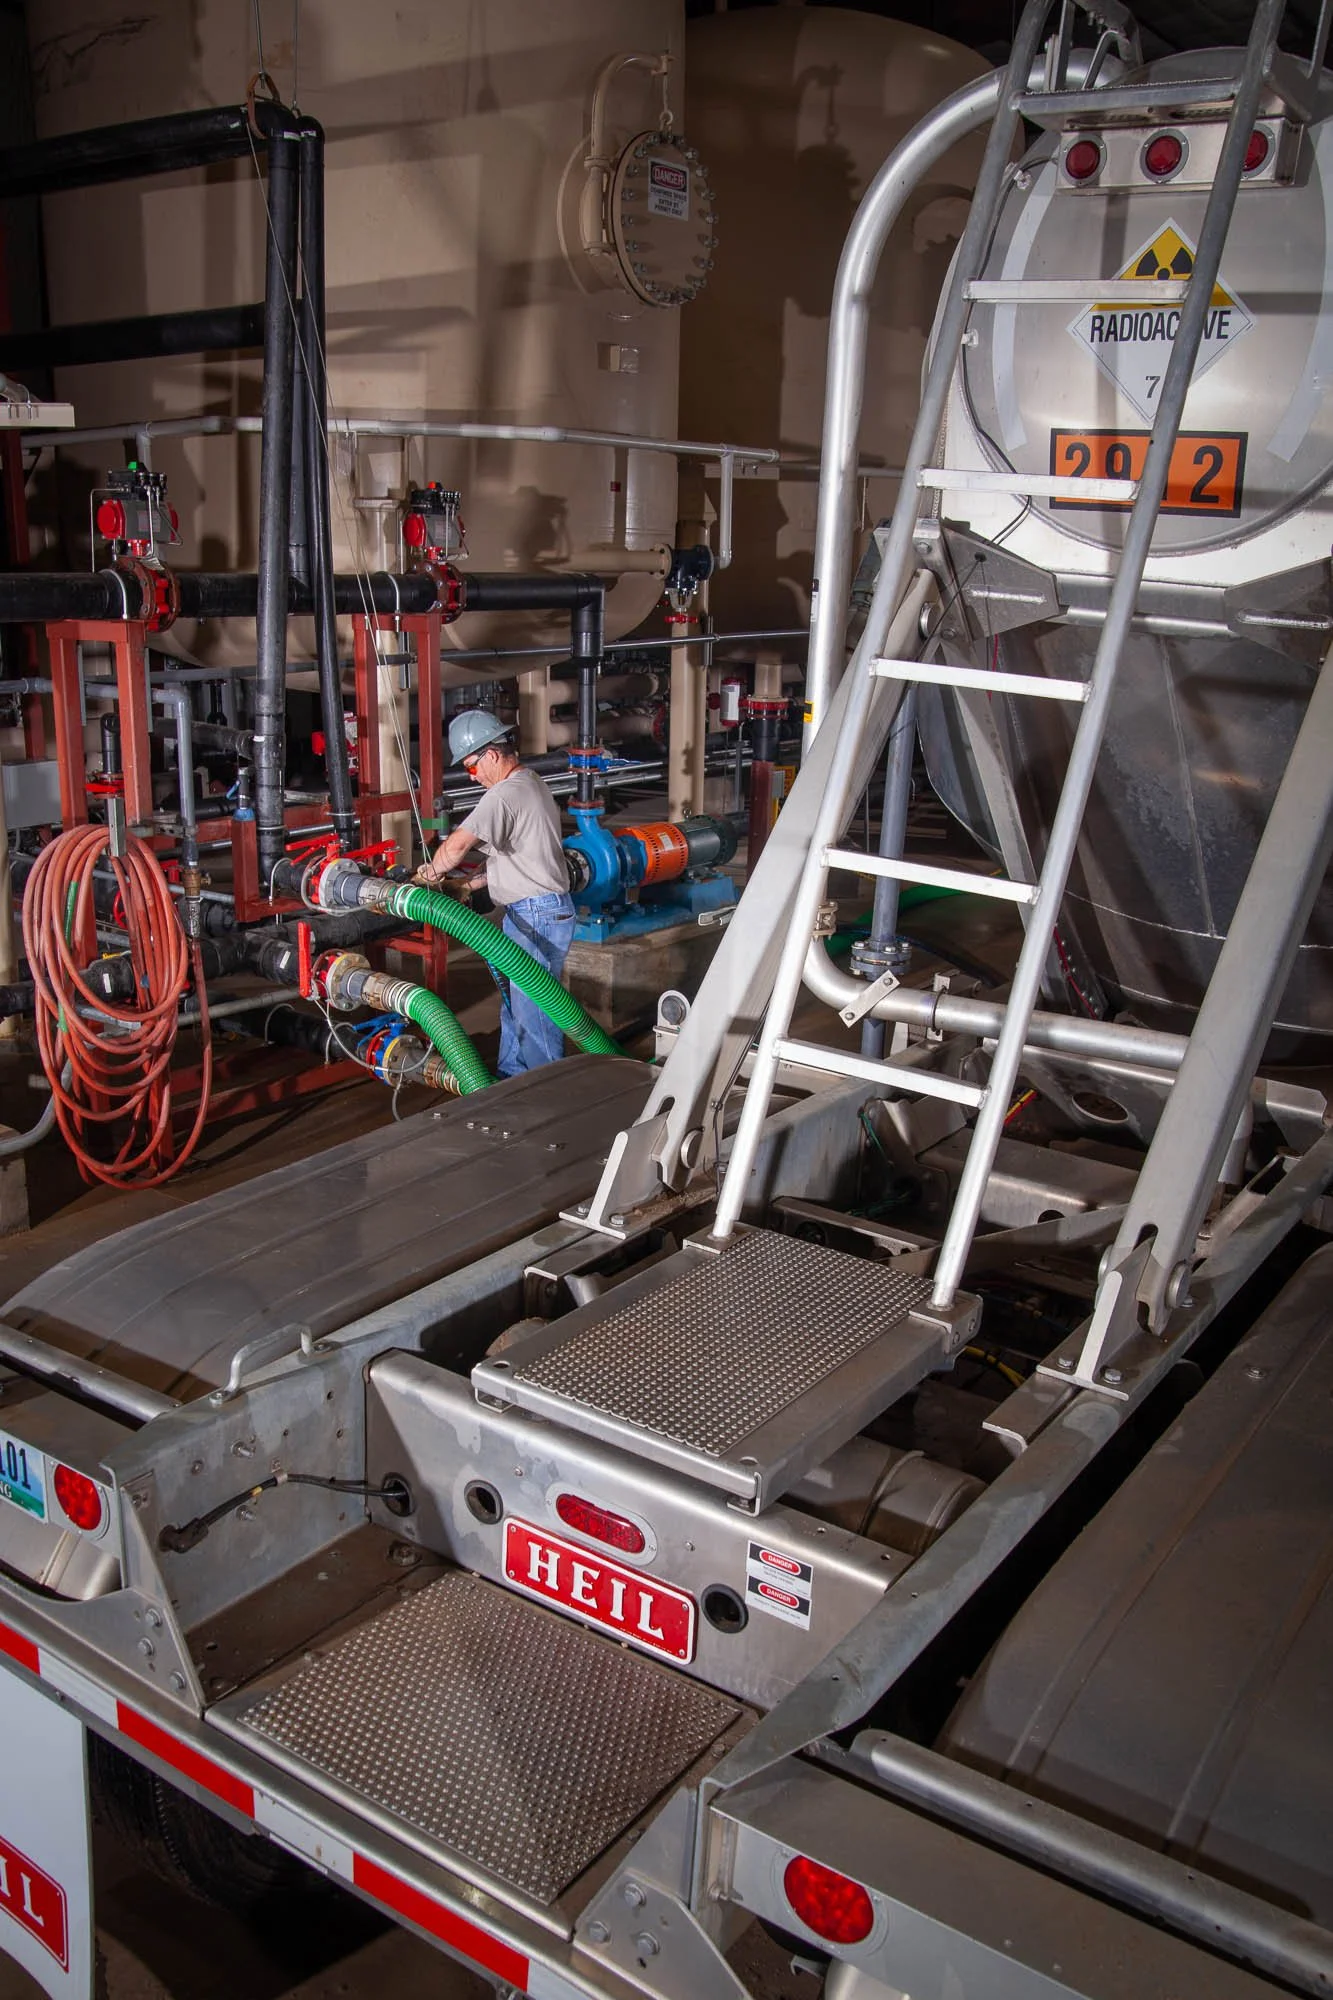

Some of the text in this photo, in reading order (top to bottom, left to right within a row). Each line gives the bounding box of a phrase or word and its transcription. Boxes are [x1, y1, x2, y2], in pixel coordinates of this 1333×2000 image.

[655, 167, 685, 186] DANGER
[1090, 309, 1232, 343] RADIOACVE
[1145, 375, 1161, 399] 7
[1065, 442, 1224, 504] 292
[767, 1554, 793, 1570] DANGER
[526, 1540, 664, 1641] HEIL
[766, 1587, 791, 1604] DANGER
